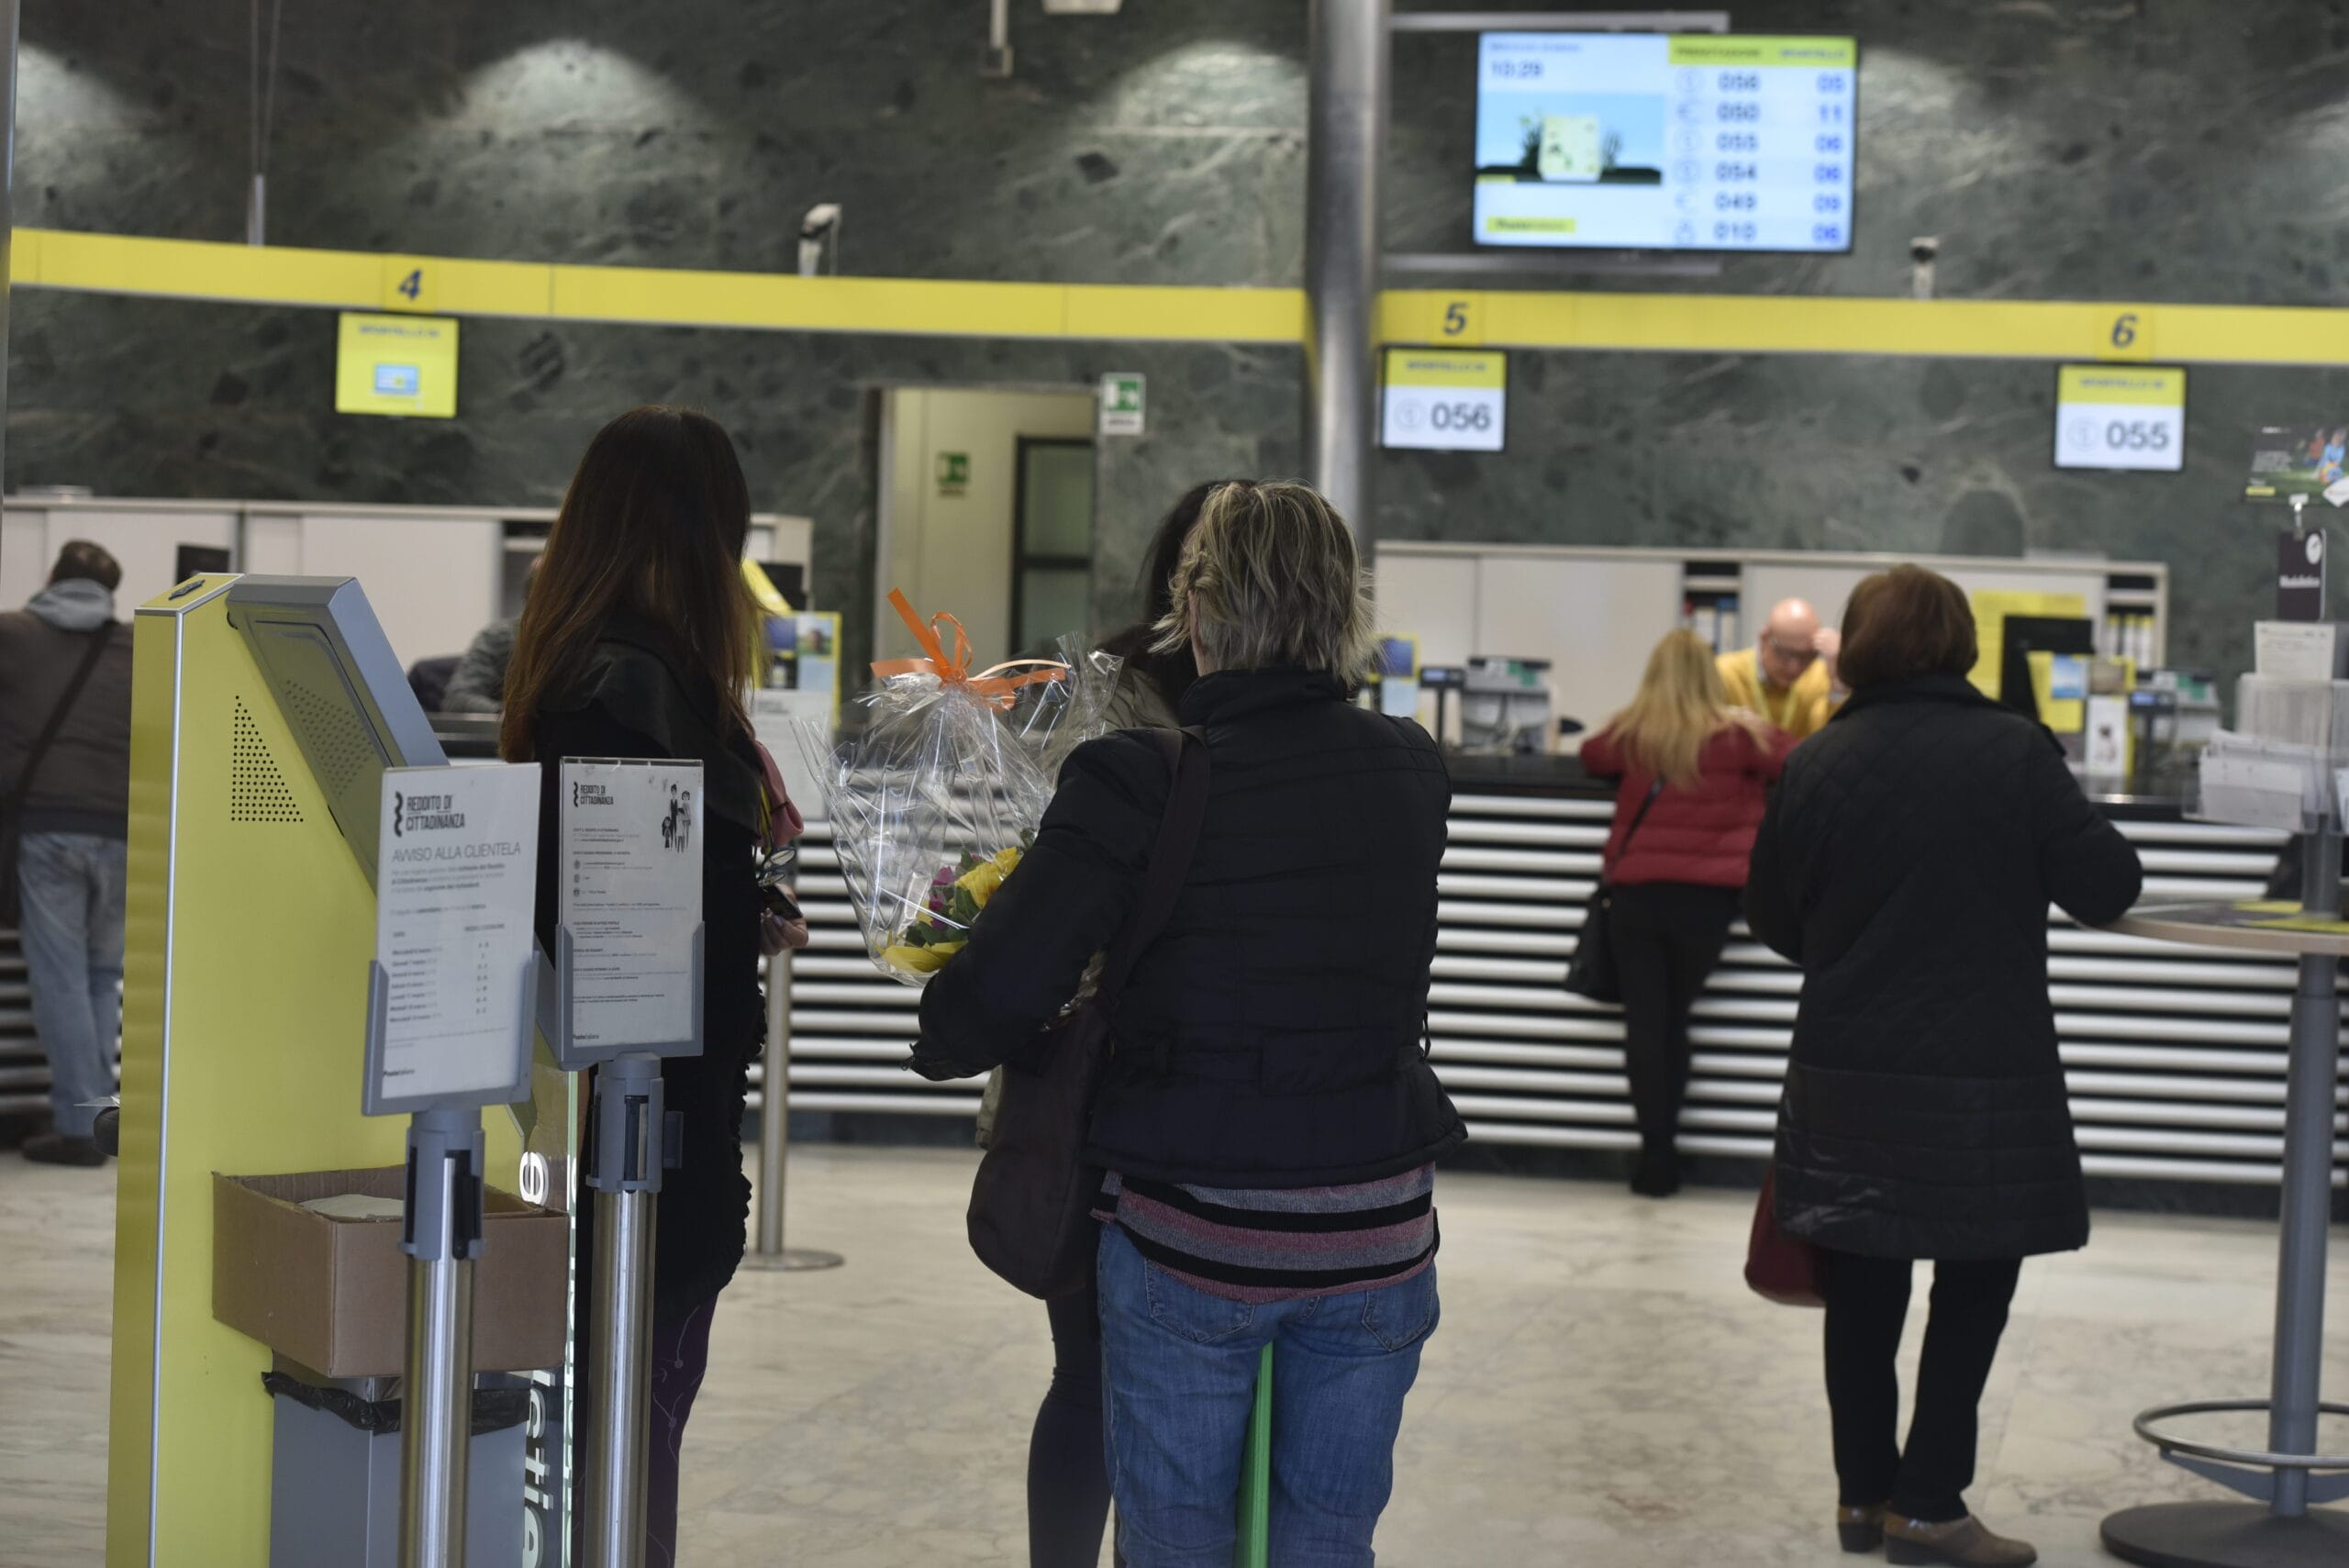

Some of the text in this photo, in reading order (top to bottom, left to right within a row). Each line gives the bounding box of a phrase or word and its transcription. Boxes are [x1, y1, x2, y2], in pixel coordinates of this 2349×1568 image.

[1718, 72, 1760, 90] 056
[1820, 104, 1842, 122] 11
[1716, 161, 1757, 182] 054
[1713, 221, 1756, 241] 010
[398, 269, 421, 301] 4
[1443, 301, 1469, 337] 5
[2111, 313, 2139, 350] 6
[1431, 402, 1492, 431] 056
[2106, 419, 2170, 450] 055
[580, 784, 600, 795] REDDITO
[406, 795, 453, 812] REDDITO DI
[580, 795, 614, 806] CITTADINANZA
[406, 813, 465, 831] CITTADINANZA
[392, 841, 521, 862] AVVISO ALLA CLIENTELA
